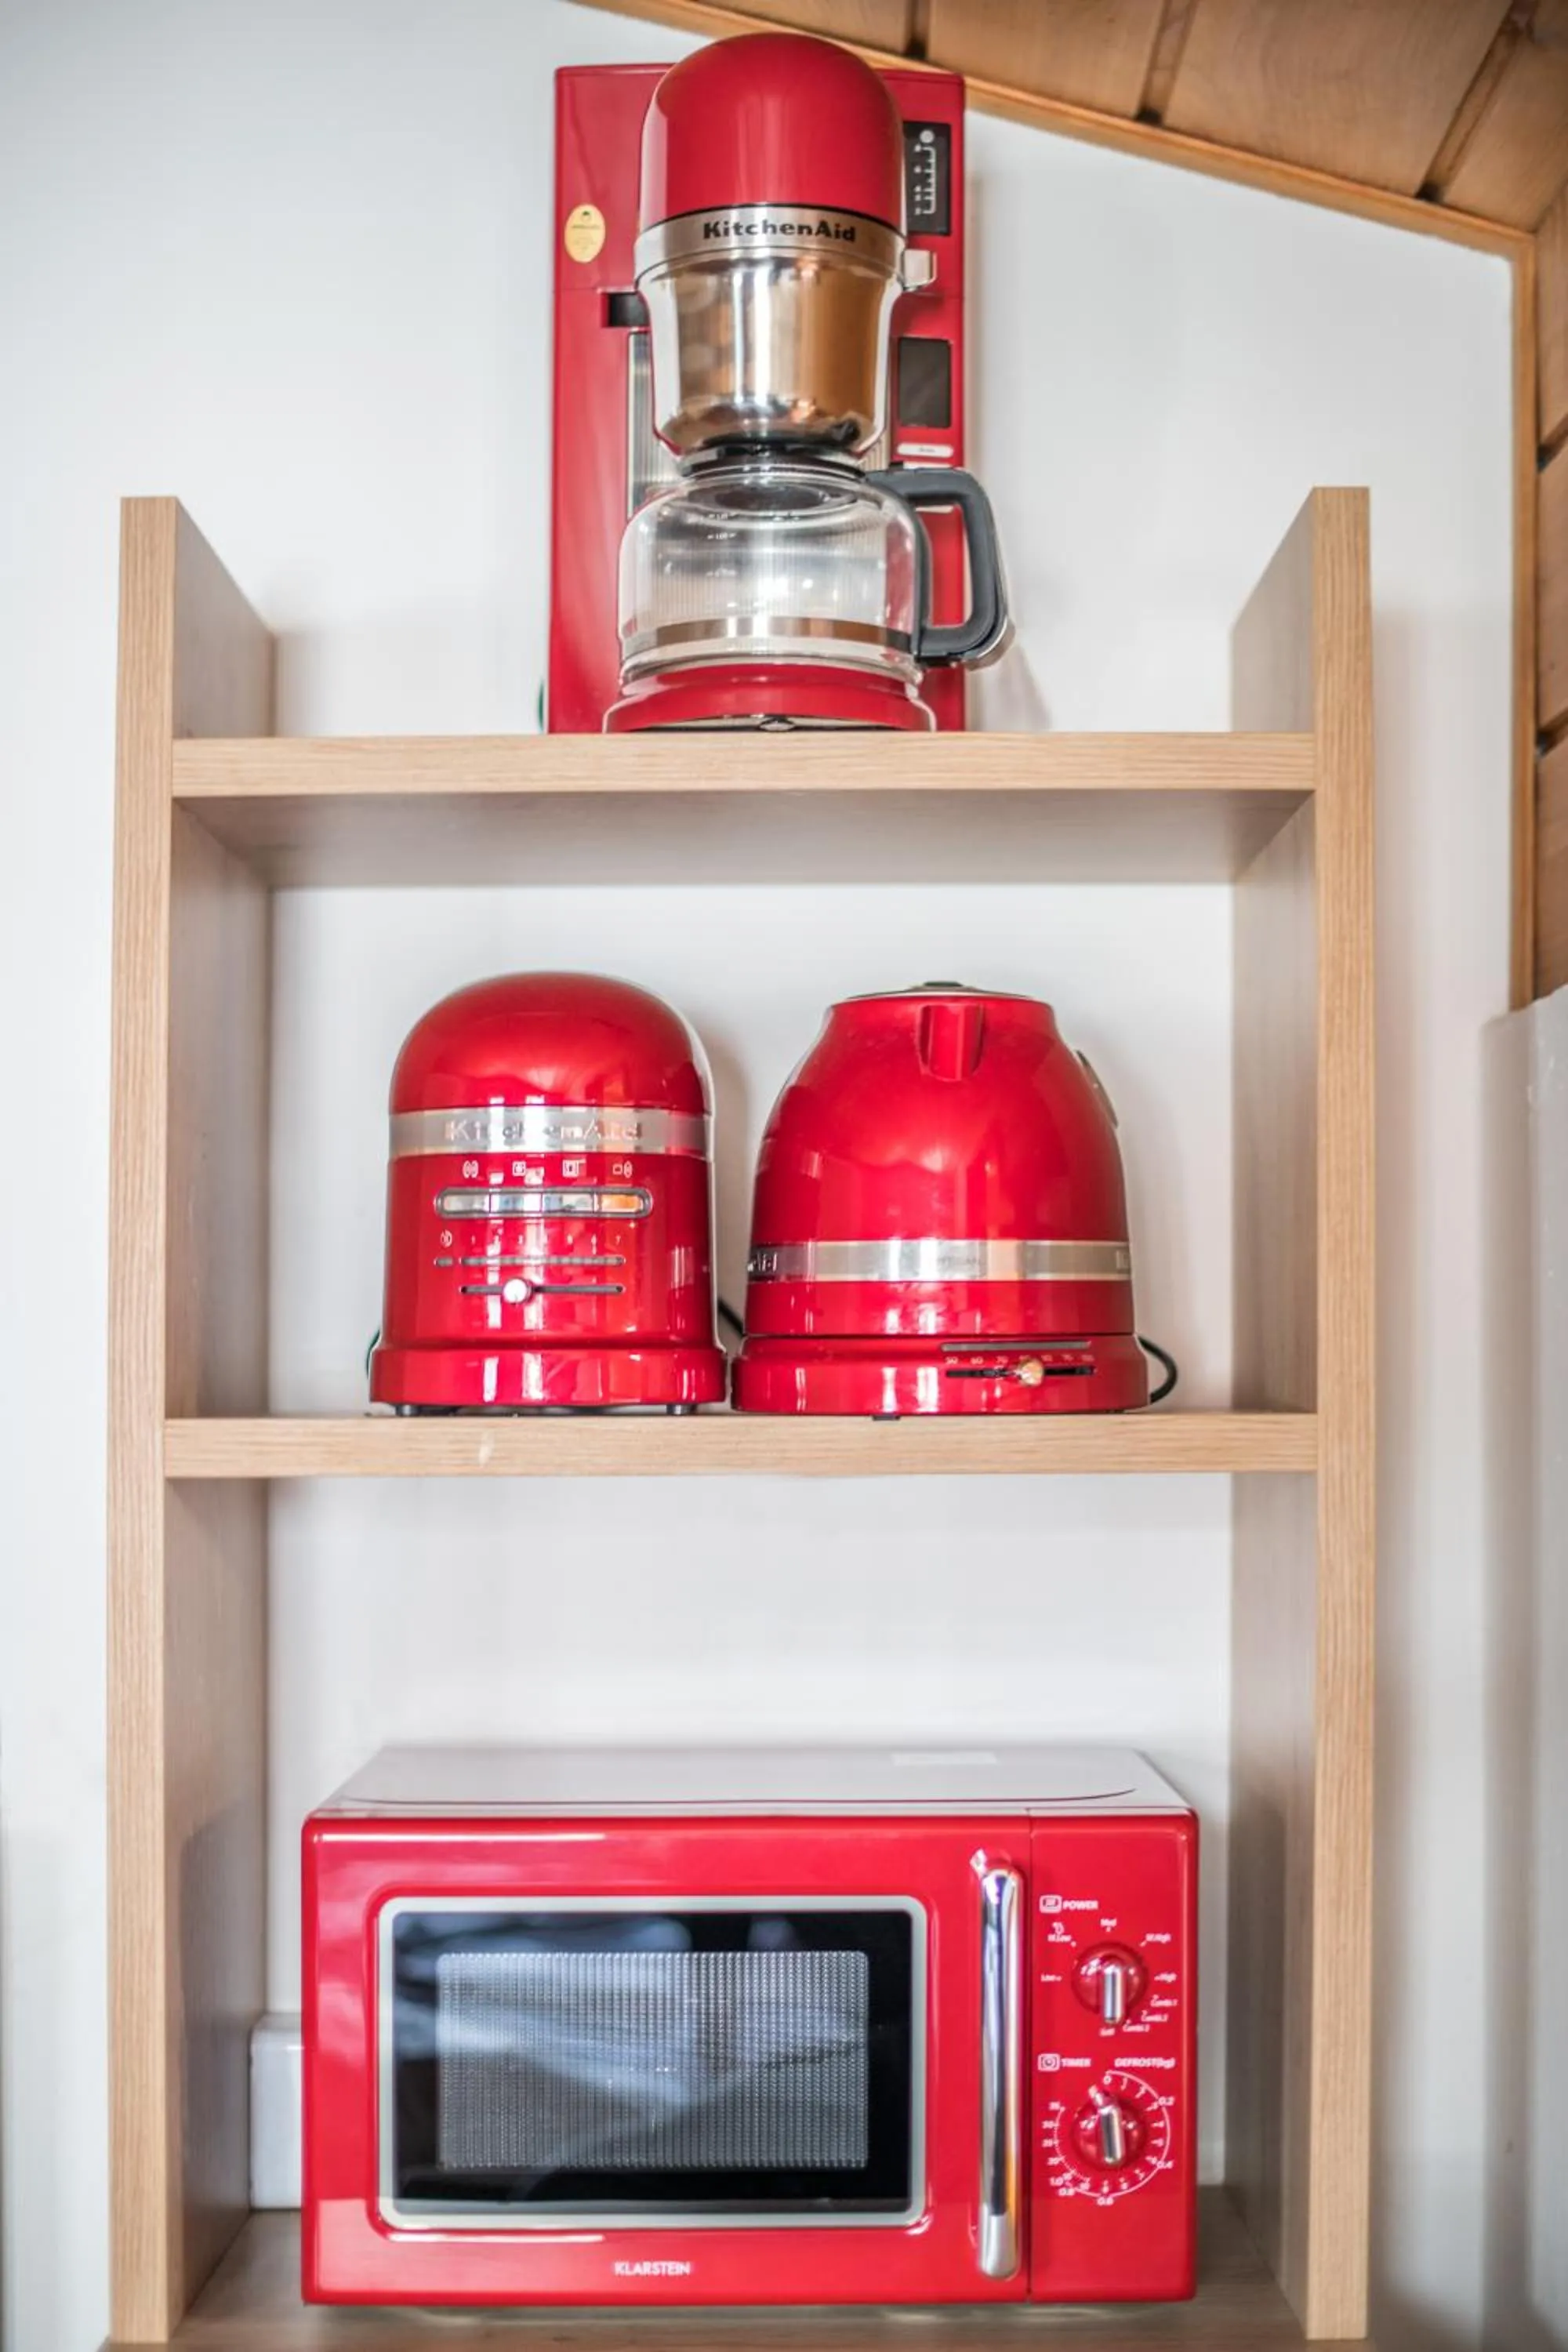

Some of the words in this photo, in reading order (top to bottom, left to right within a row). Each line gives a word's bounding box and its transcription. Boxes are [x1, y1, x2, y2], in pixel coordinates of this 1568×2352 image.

[703, 220, 856, 242] KitchenAid
[448, 1119, 643, 1141] KicenAid
[1063, 1900, 1098, 1910] POWER
[1062, 2058, 1092, 2067] TIMER
[614, 2260, 691, 2277] KLARSTEIN
